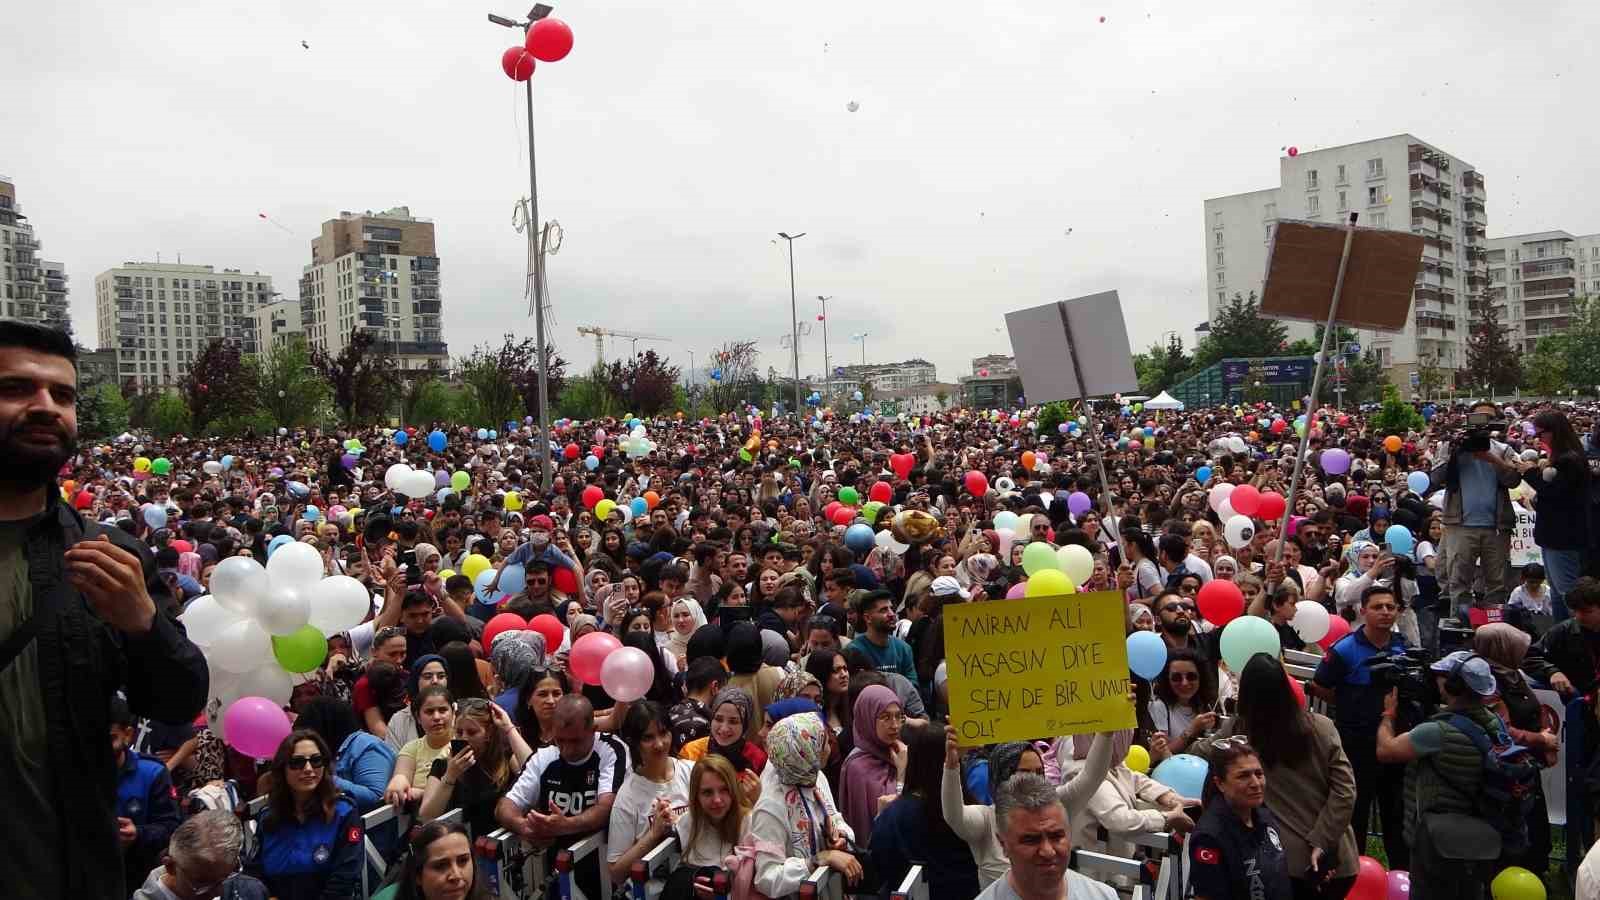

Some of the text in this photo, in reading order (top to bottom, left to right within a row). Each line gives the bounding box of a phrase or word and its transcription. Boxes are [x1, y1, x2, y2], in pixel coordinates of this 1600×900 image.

[968, 679, 1130, 713] SEN DE BİR UMUT
